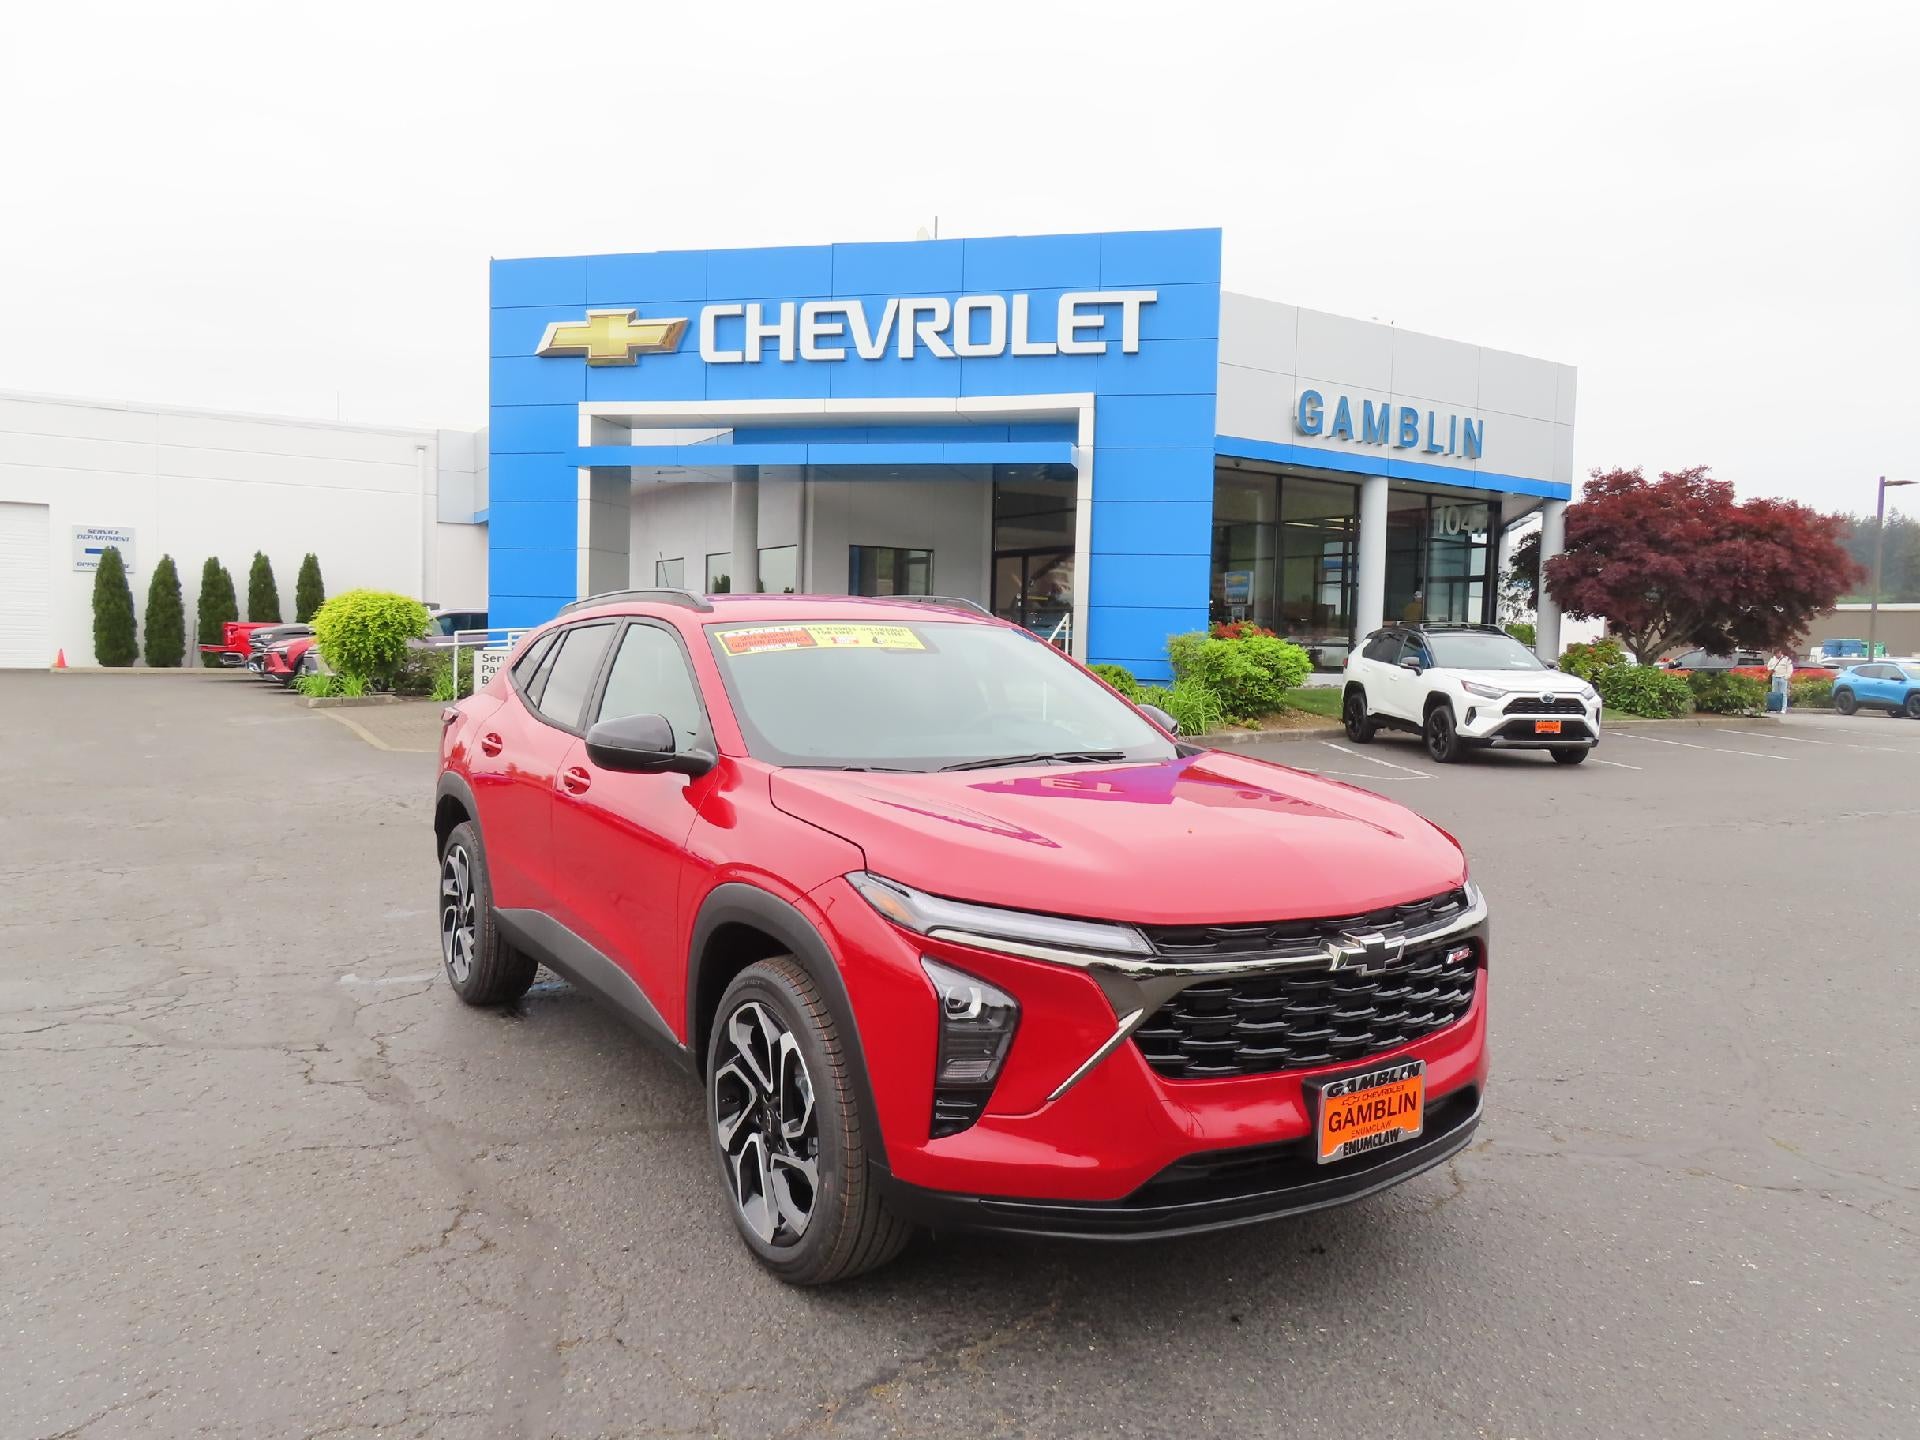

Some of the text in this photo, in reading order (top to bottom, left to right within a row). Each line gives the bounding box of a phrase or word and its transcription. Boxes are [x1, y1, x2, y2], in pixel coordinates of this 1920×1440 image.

[701, 289, 1158, 364] CHEVROLET
[1297, 389, 1484, 459] GAMBLIN
[77, 534, 130, 542] DEPARTMENT
[1327, 1062, 1422, 1097] GAMBLIN
[1362, 1085, 1404, 1101] CHEVROLET
[1328, 1091, 1417, 1132] GAMBLIN
[1343, 1127, 1401, 1156] ENUMCLAW
[1351, 1120, 1391, 1138] ENUMCLAW
